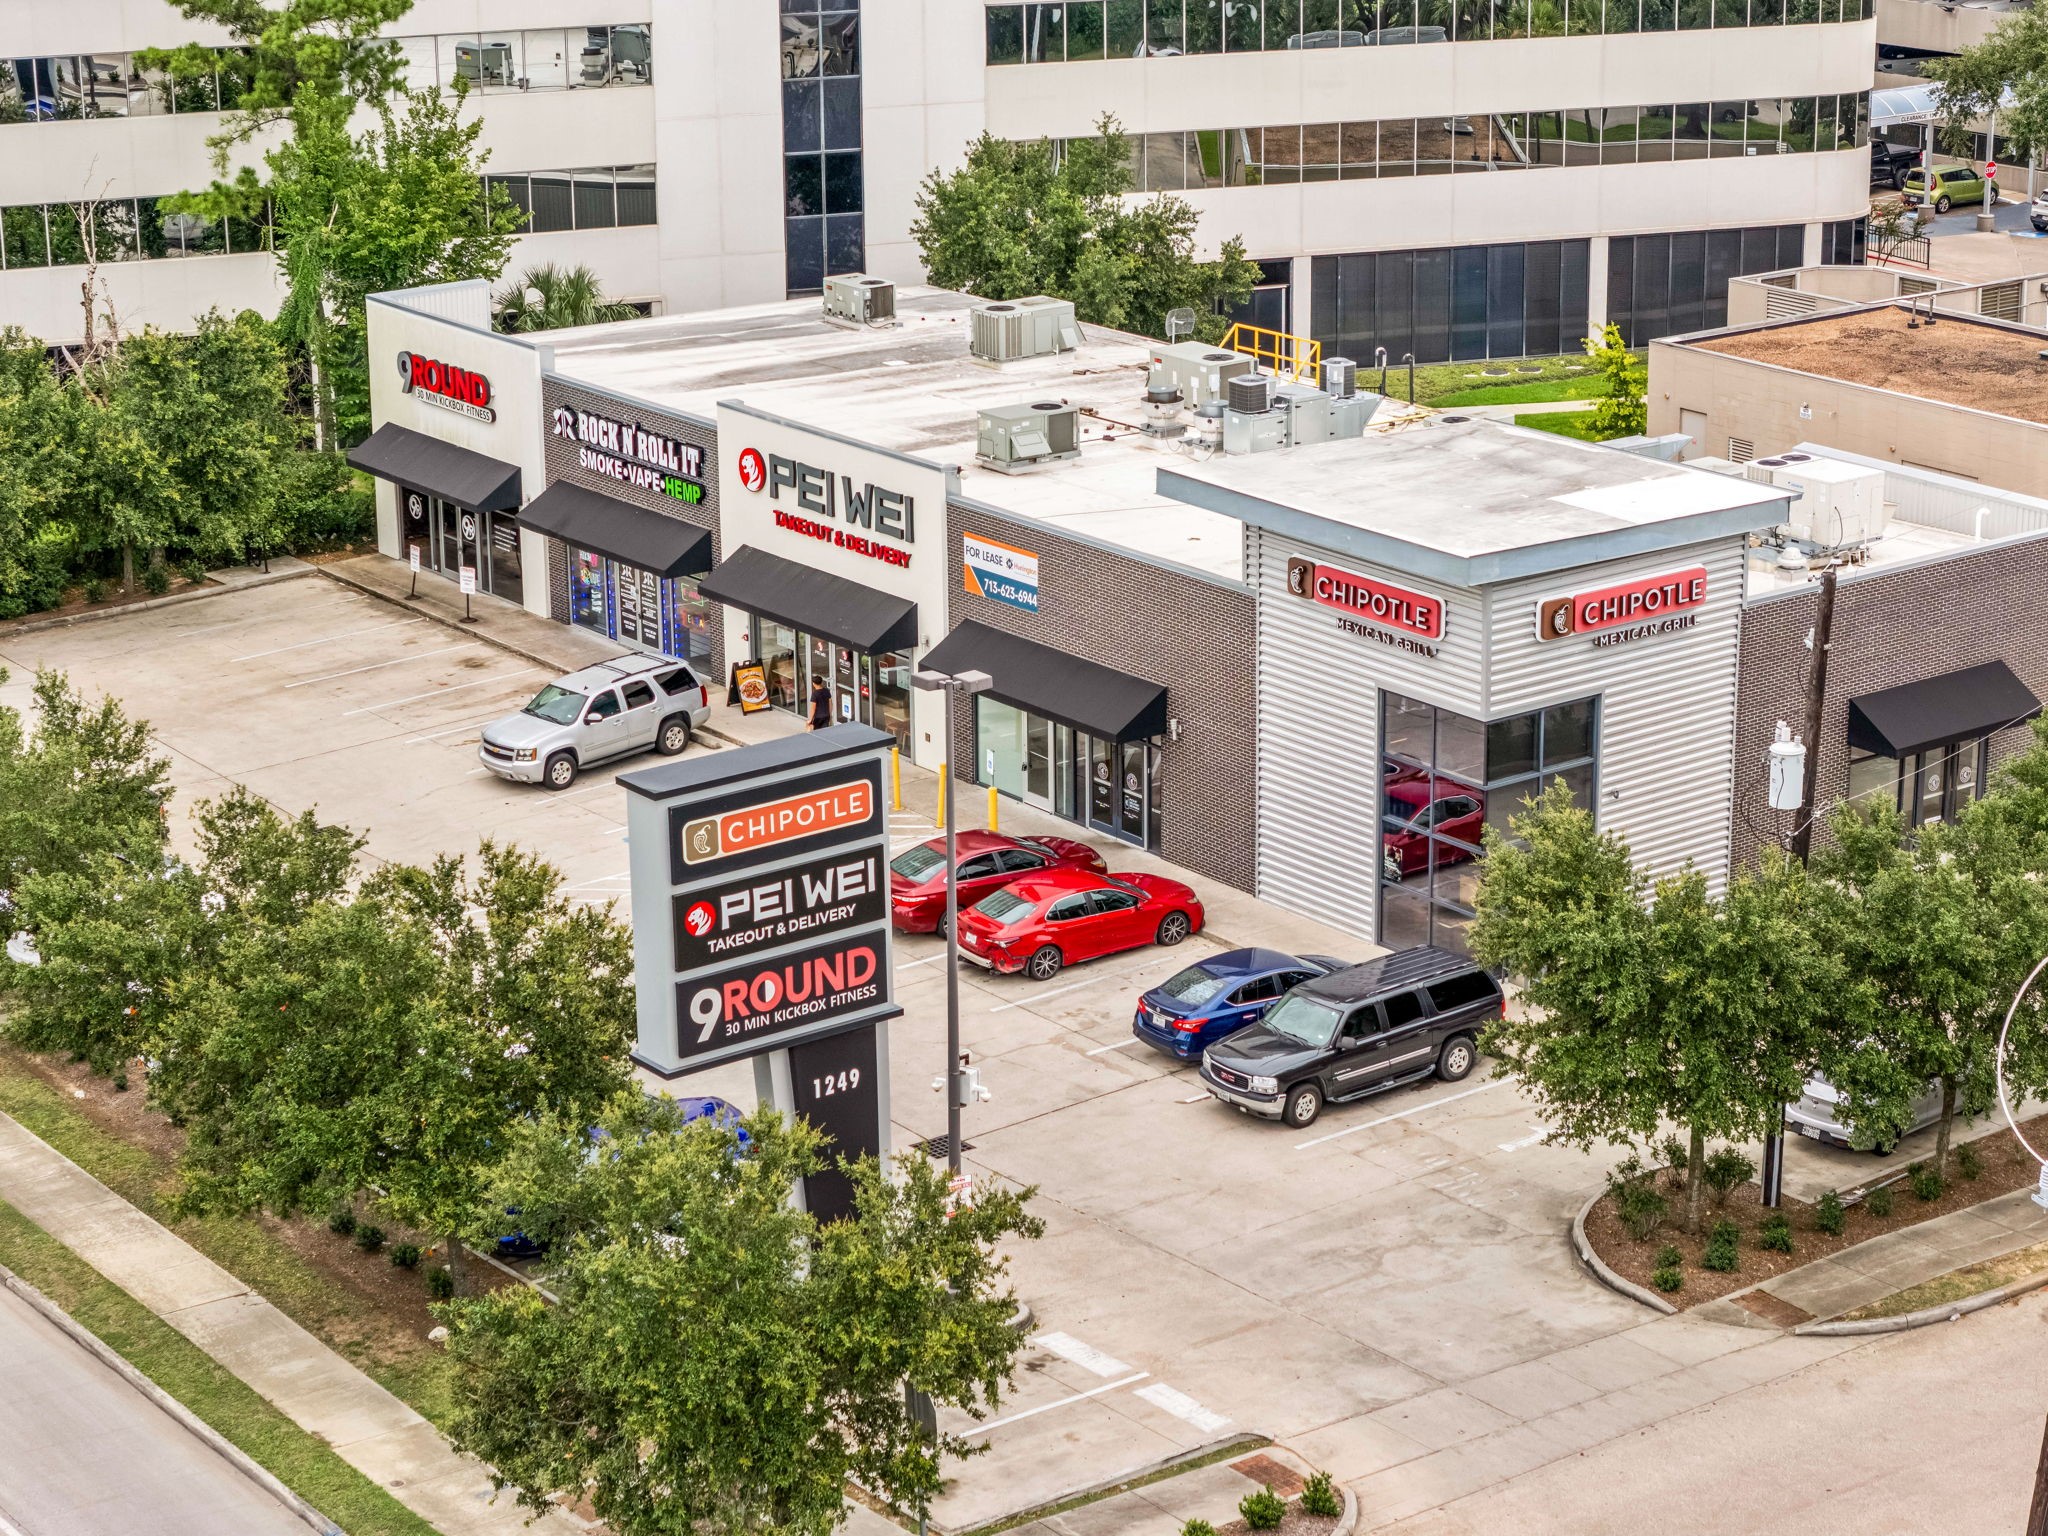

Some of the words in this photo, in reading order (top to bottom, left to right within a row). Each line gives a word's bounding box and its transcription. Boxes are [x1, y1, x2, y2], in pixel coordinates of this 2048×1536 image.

[417, 389, 424, 399] 30
[426, 391, 438, 404] MIN
[439, 395, 465, 411] KICKBOX
[466, 405, 490, 420] FITNESS
[578, 412, 620, 451] ROCK
[637, 432, 678, 471] ROLL
[680, 444, 701, 477] IT
[768, 453, 836, 518] PEI
[841, 475, 916, 544] WEI
[773, 510, 834, 543] TAKEOUT
[834, 531, 845, 547] &
[845, 534, 912, 569] DELIVERY
[965, 545, 980, 559] FOR
[982, 550, 1003, 567] LEASE
[983, 578, 1038, 607] 713-623-6944
[1316, 577, 1428, 630] CHIPOTLE
[1583, 578, 1704, 625] CHIPOTLE
[1335, 618, 1391, 645] MEXICAN
[1396, 638, 1433, 659] GRILL
[1599, 624, 1659, 648] MEXICAN
[1663, 615, 1700, 633] GRILL
[727, 791, 864, 843] CHIPOTLE
[720, 878, 794, 931] PEI
[801, 857, 876, 909] WEI
[707, 925, 774, 953] TAKEOUT
[776, 922, 787, 936] &
[788, 903, 857, 933] DELIVERY
[725, 1023, 740, 1037] 30
[744, 1014, 770, 1032] MIN
[774, 998, 827, 1023] KICKBOX
[830, 984, 877, 1007] FITNESS
[813, 1068, 860, 1099] 1249
